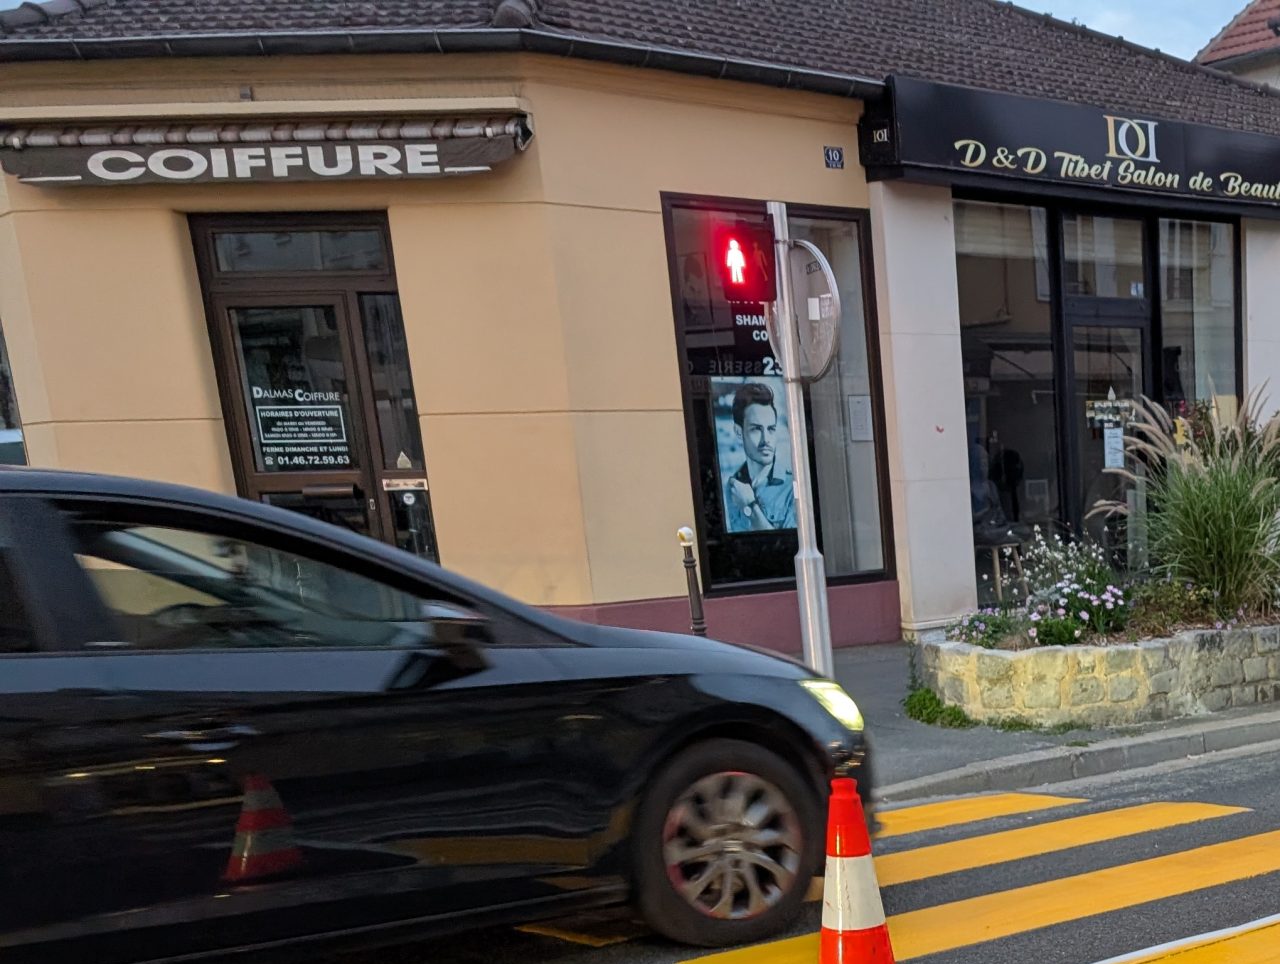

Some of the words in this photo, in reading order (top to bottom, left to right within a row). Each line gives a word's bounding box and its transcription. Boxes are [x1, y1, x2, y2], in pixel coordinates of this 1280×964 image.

[829, 149, 839, 161] 10
[87, 144, 441, 180] COIFFURE
[1054, 151, 1113, 181] Tibet
[1118, 159, 1180, 188] Salon
[1189, 171, 1213, 192] de
[294, 389, 340, 402] COIFFURE
[260, 410, 293, 418] HORAIRES
[277, 455, 350, 465] 01.46.72.59.63
